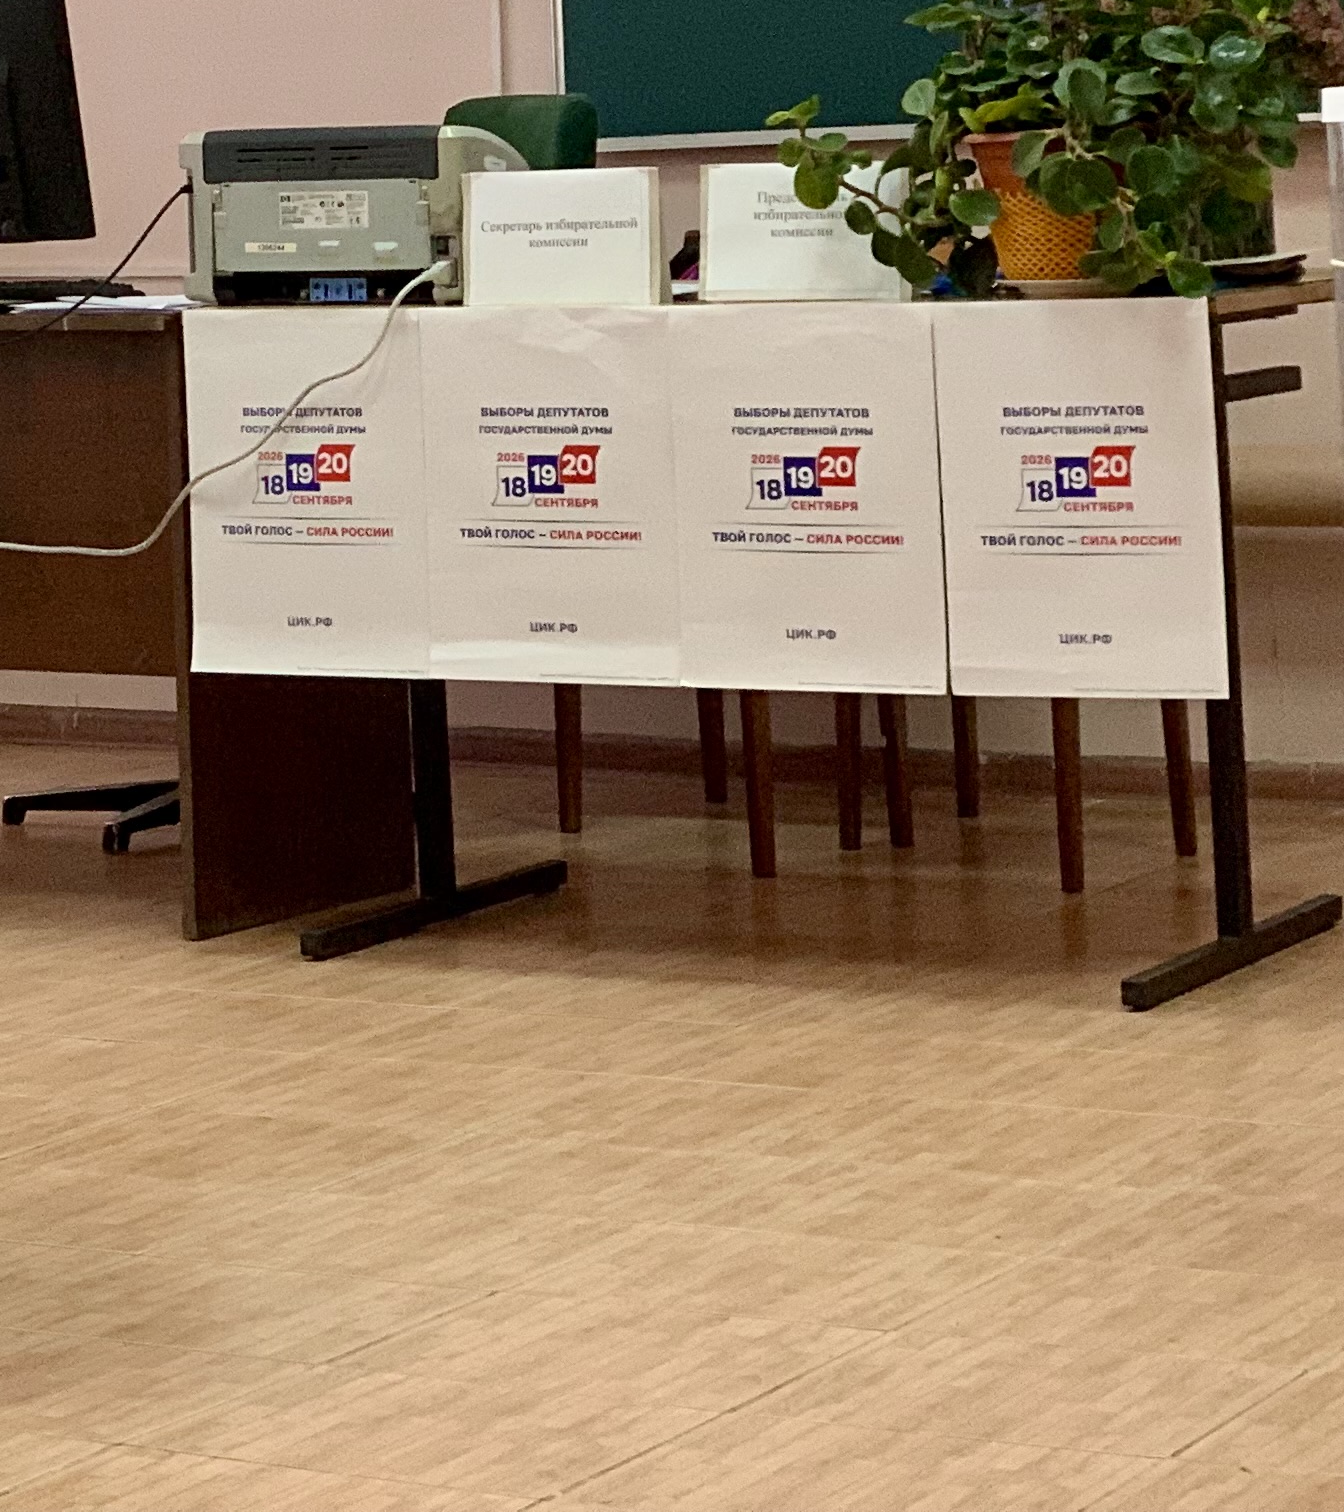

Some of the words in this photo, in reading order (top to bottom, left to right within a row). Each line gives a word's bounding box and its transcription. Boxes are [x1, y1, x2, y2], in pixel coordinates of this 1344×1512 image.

[754, 209, 843, 223] избирательно
[480, 220, 543, 234] Секретарь
[546, 217, 638, 233] избирательной
[528, 238, 588, 248] комиссии
[295, 407, 362, 418] ДЕПУТАТОВ
[481, 407, 534, 417] ВЫБОРЫ
[537, 407, 609, 418] ДЕПУТАТОВ
[734, 408, 791, 418] ВЫБОРЫ
[793, 408, 869, 419] ДЕПУТАТОВ
[1003, 406, 1061, 417] ВЫБОРЫ
[1064, 406, 1144, 417] ДЕПУТАТОВ
[336, 425, 366, 435] ДУМЫ
[479, 424, 579, 435] ГОСУДАРСТВЕННОЙ
[581, 425, 613, 435] ДУМЫ
[731, 425, 838, 436] ГОСУДАРСТВЕННОЙ
[840, 426, 874, 436] ДУМЫ
[1000, 424, 1110, 435] ГОСУДАРСТВЕННОЙ
[1113, 425, 1149, 435] ДУМЫ
[258, 452, 283, 461] 2026
[497, 452, 525, 462] 2026
[751, 454, 780, 464] 2026
[1021, 454, 1052, 465] 2026
[261, 475, 285, 495] 18
[288, 463, 313, 485] 19
[318, 452, 348, 474] 20
[501, 476, 527, 497] 18
[530, 464, 557, 486] 19
[562, 454, 594, 476] 20
[755, 479, 783, 500] 18
[786, 466, 814, 489] 19
[819, 456, 853, 478] 20
[1026, 480, 1054, 502] 18
[1058, 466, 1088, 490] 19
[1093, 454, 1129, 478] 20
[293, 495, 352, 505] СЕНТЯБРЯ
[534, 498, 599, 508] СЕНТЯБРЯ
[791, 500, 858, 511] СЕНТЯБРЯ
[1063, 501, 1134, 512] СЕНТЯБРЯ
[222, 523, 252, 535] ТВОЙ
[255, 526, 293, 536] ГОЛОС
[306, 527, 338, 537] СИЛА
[342, 527, 394, 537] РОССИИ!
[460, 526, 492, 538] ТВОЙ
[495, 528, 535, 539] ГОЛОС
[550, 530, 583, 540] СИЛА
[586, 530, 642, 540] РОССИИ!
[712, 530, 746, 543] ТВОЙ
[749, 533, 791, 544] ГОЛОС
[807, 534, 842, 544] СИЛА
[846, 534, 904, 545] РОССИИ!
[981, 533, 1015, 546] ТВОЙ
[1019, 535, 1064, 546] ГОЛОС
[1080, 535, 1117, 546] СИЛА
[1121, 535, 1182, 546] РОССИИ!
[287, 616, 333, 627] ЦИК.РФ
[529, 622, 578, 633] ЦИК.РФ
[785, 628, 837, 640] ЦИК.РФ
[1059, 633, 1113, 645] ЦИК.РФ
